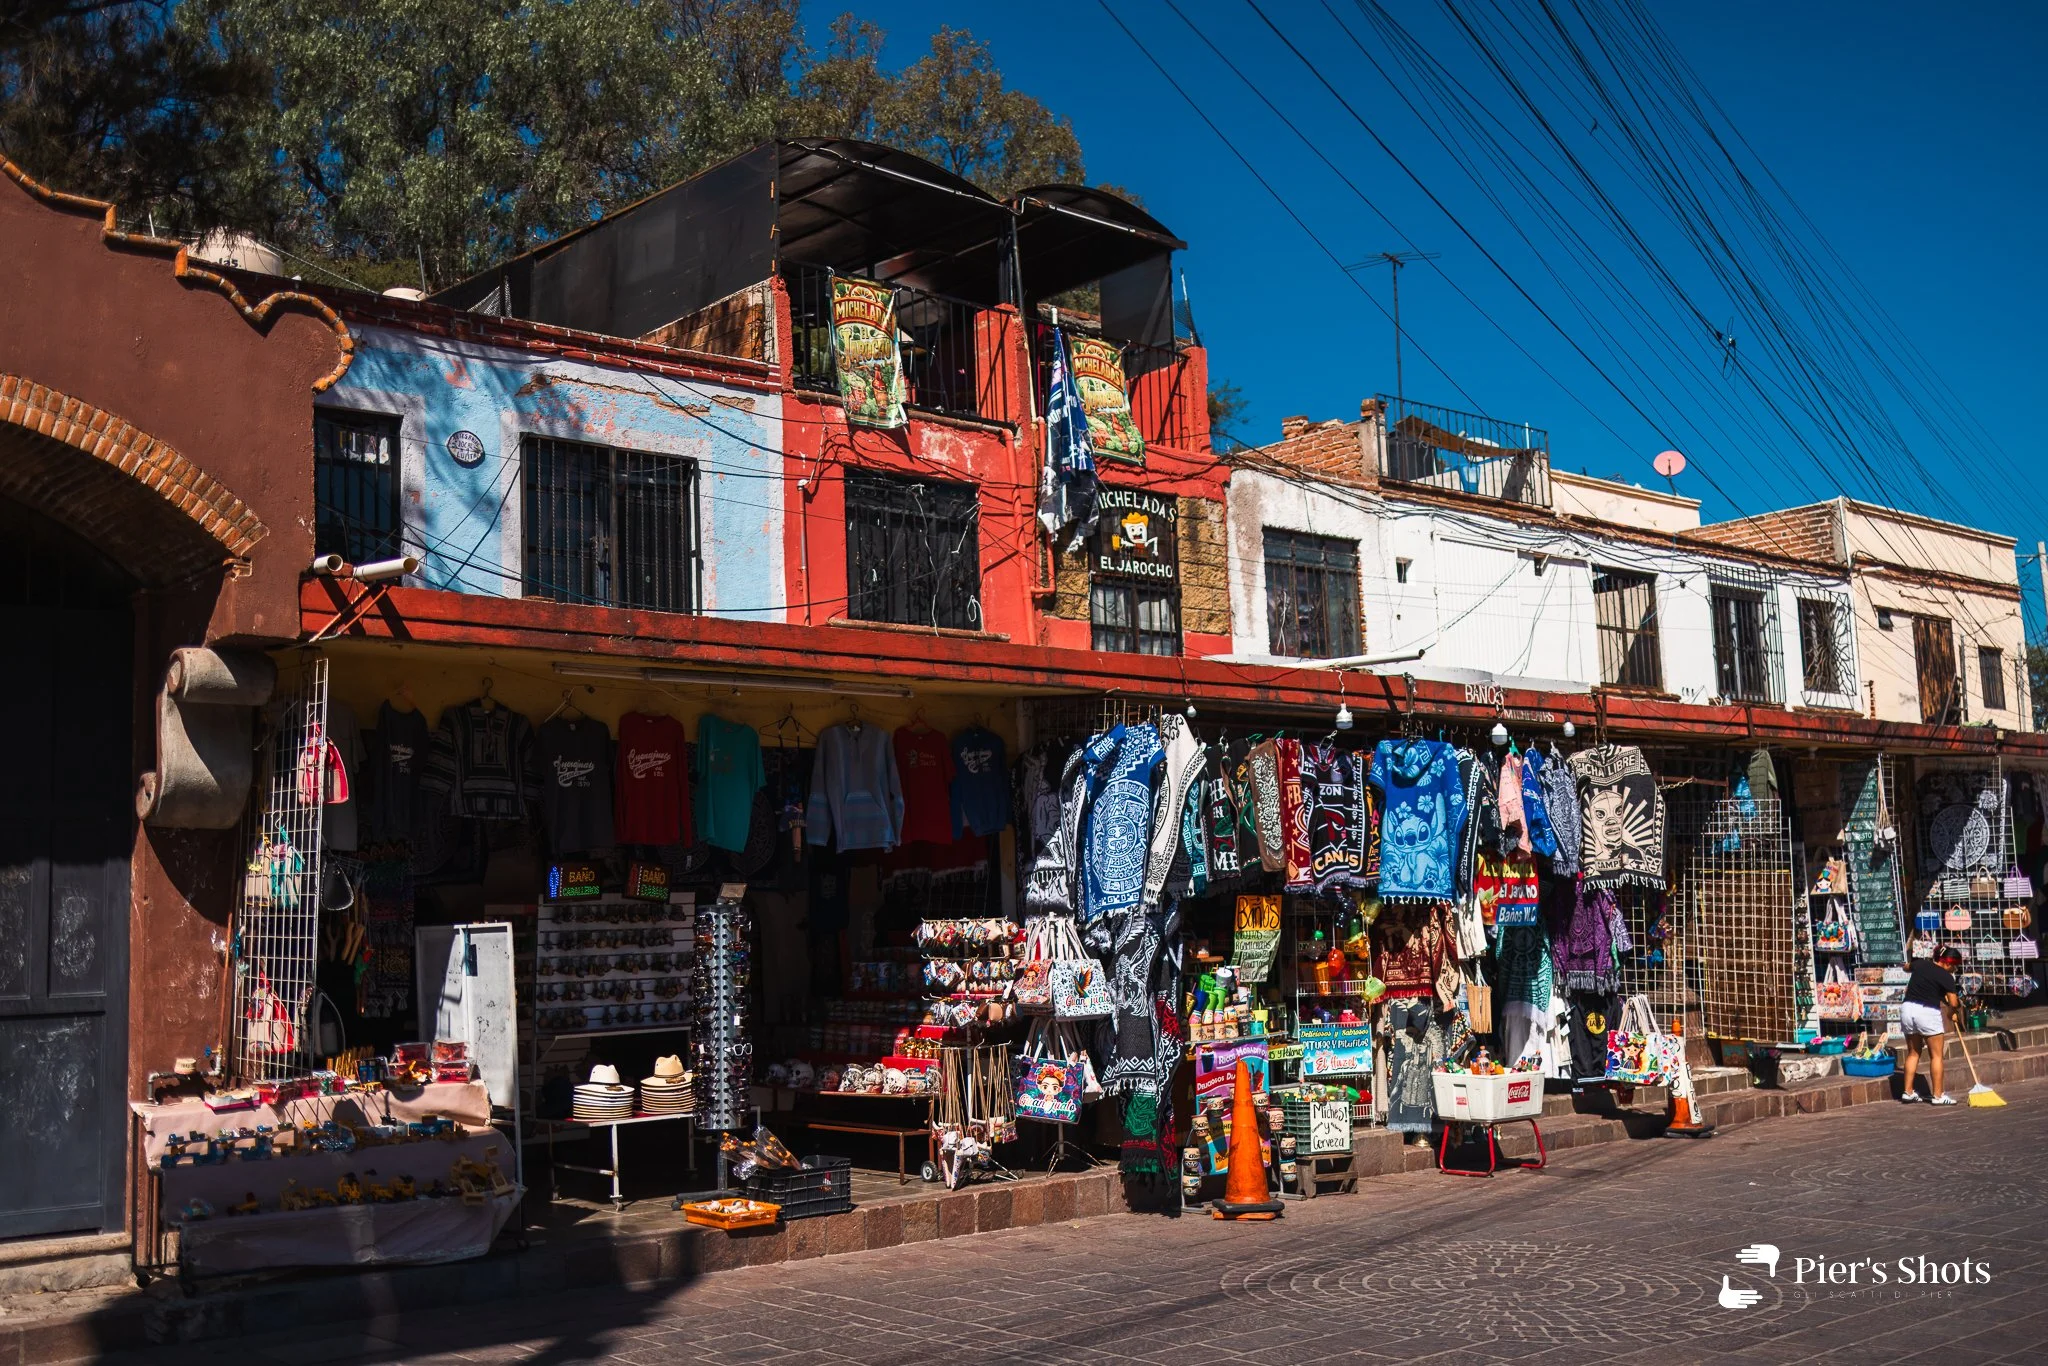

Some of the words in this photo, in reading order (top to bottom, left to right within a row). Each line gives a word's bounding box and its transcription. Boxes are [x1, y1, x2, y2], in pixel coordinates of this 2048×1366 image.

[1101, 555, 1114, 570] EL
[1116, 559, 1173, 578] JAROCHO
[1607, 754, 1636, 776] LIBRE
[569, 867, 595, 883] BAÑO
[642, 867, 666, 885] BAÑO
[1313, 1104, 1348, 1123] Miches!
[1313, 1135, 1345, 1150] Cerveza
